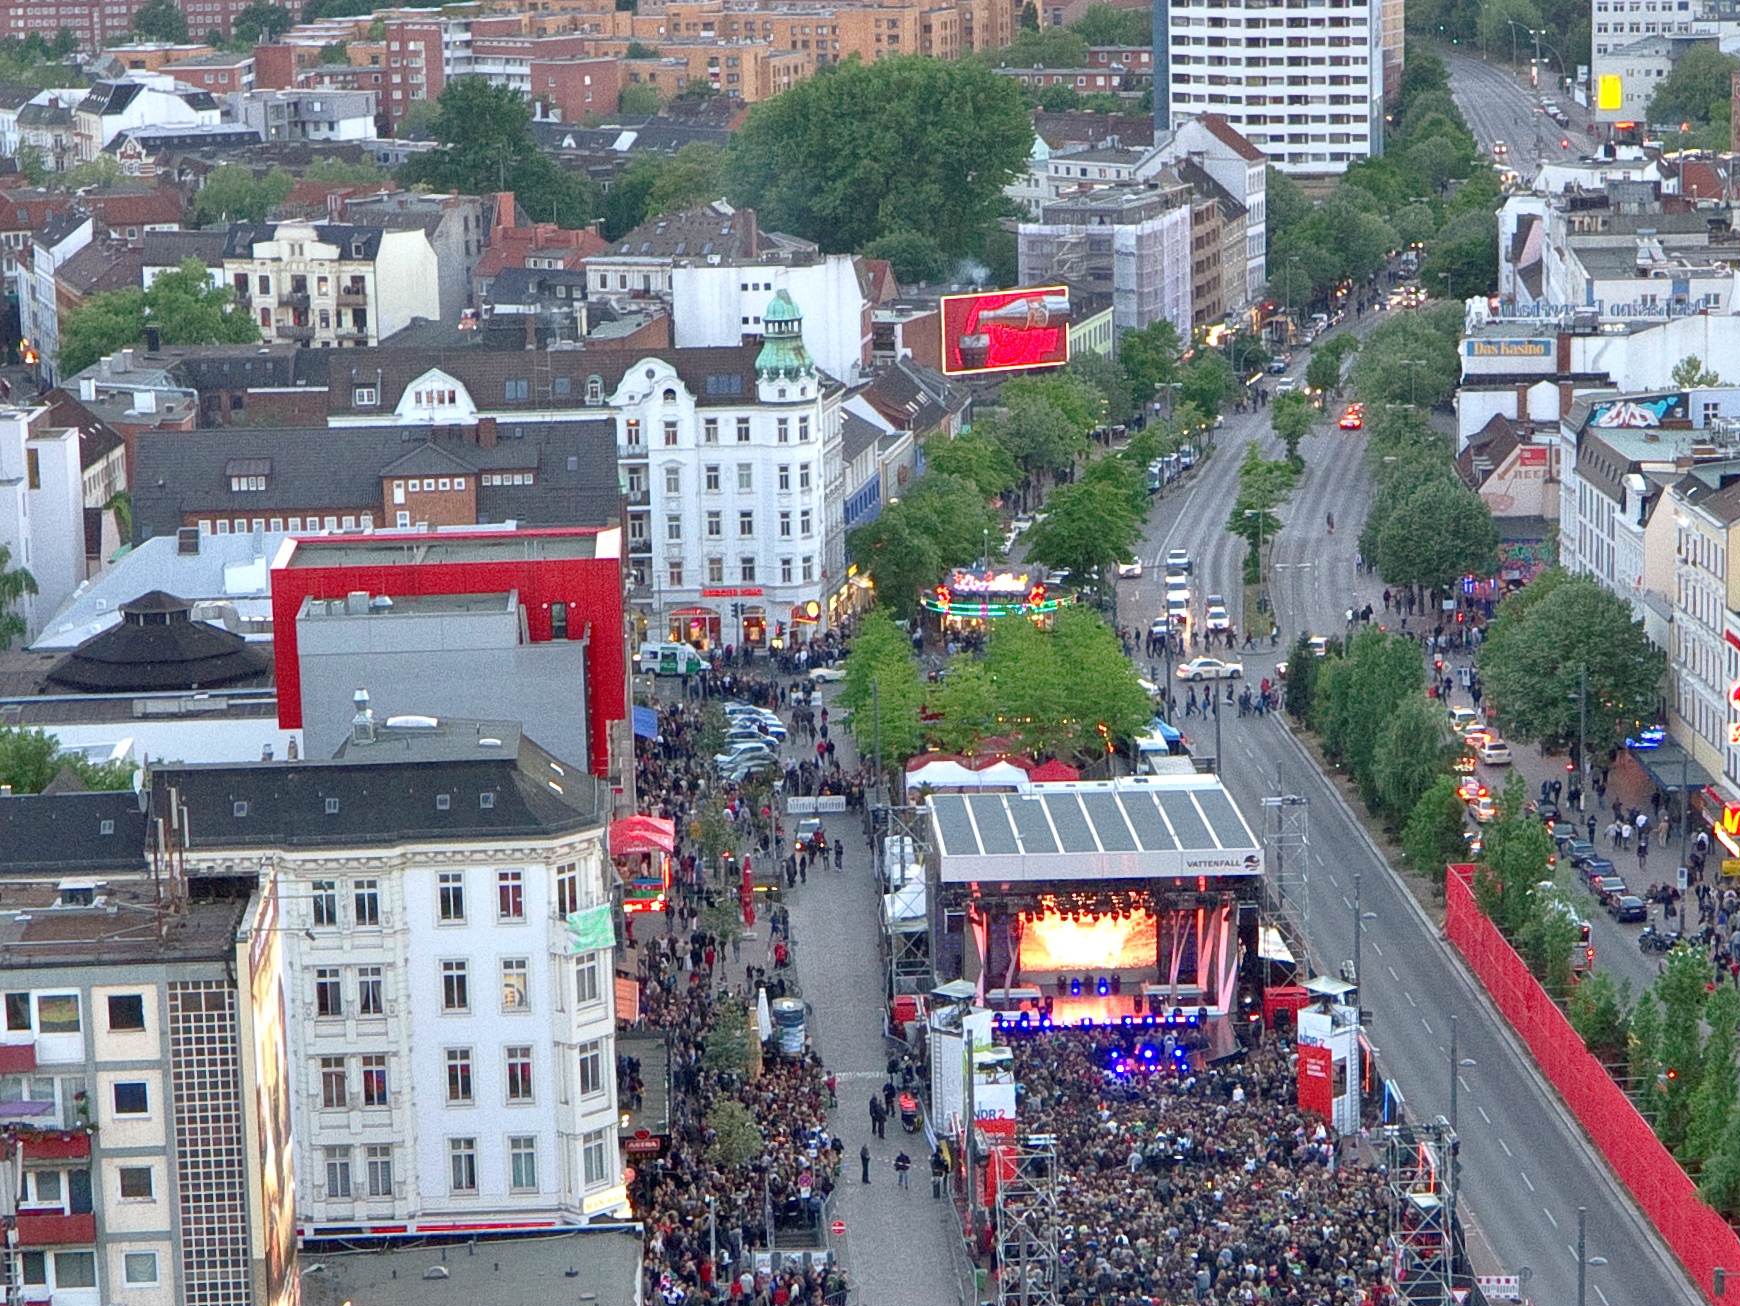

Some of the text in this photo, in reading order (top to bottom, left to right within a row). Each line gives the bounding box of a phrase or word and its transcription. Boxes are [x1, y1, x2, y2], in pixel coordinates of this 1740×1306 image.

[1473, 340, 1545, 355] Das Kasino
[1186, 859, 1242, 868] VATTENFALL
[973, 1108, 1005, 1120] NDR 2
